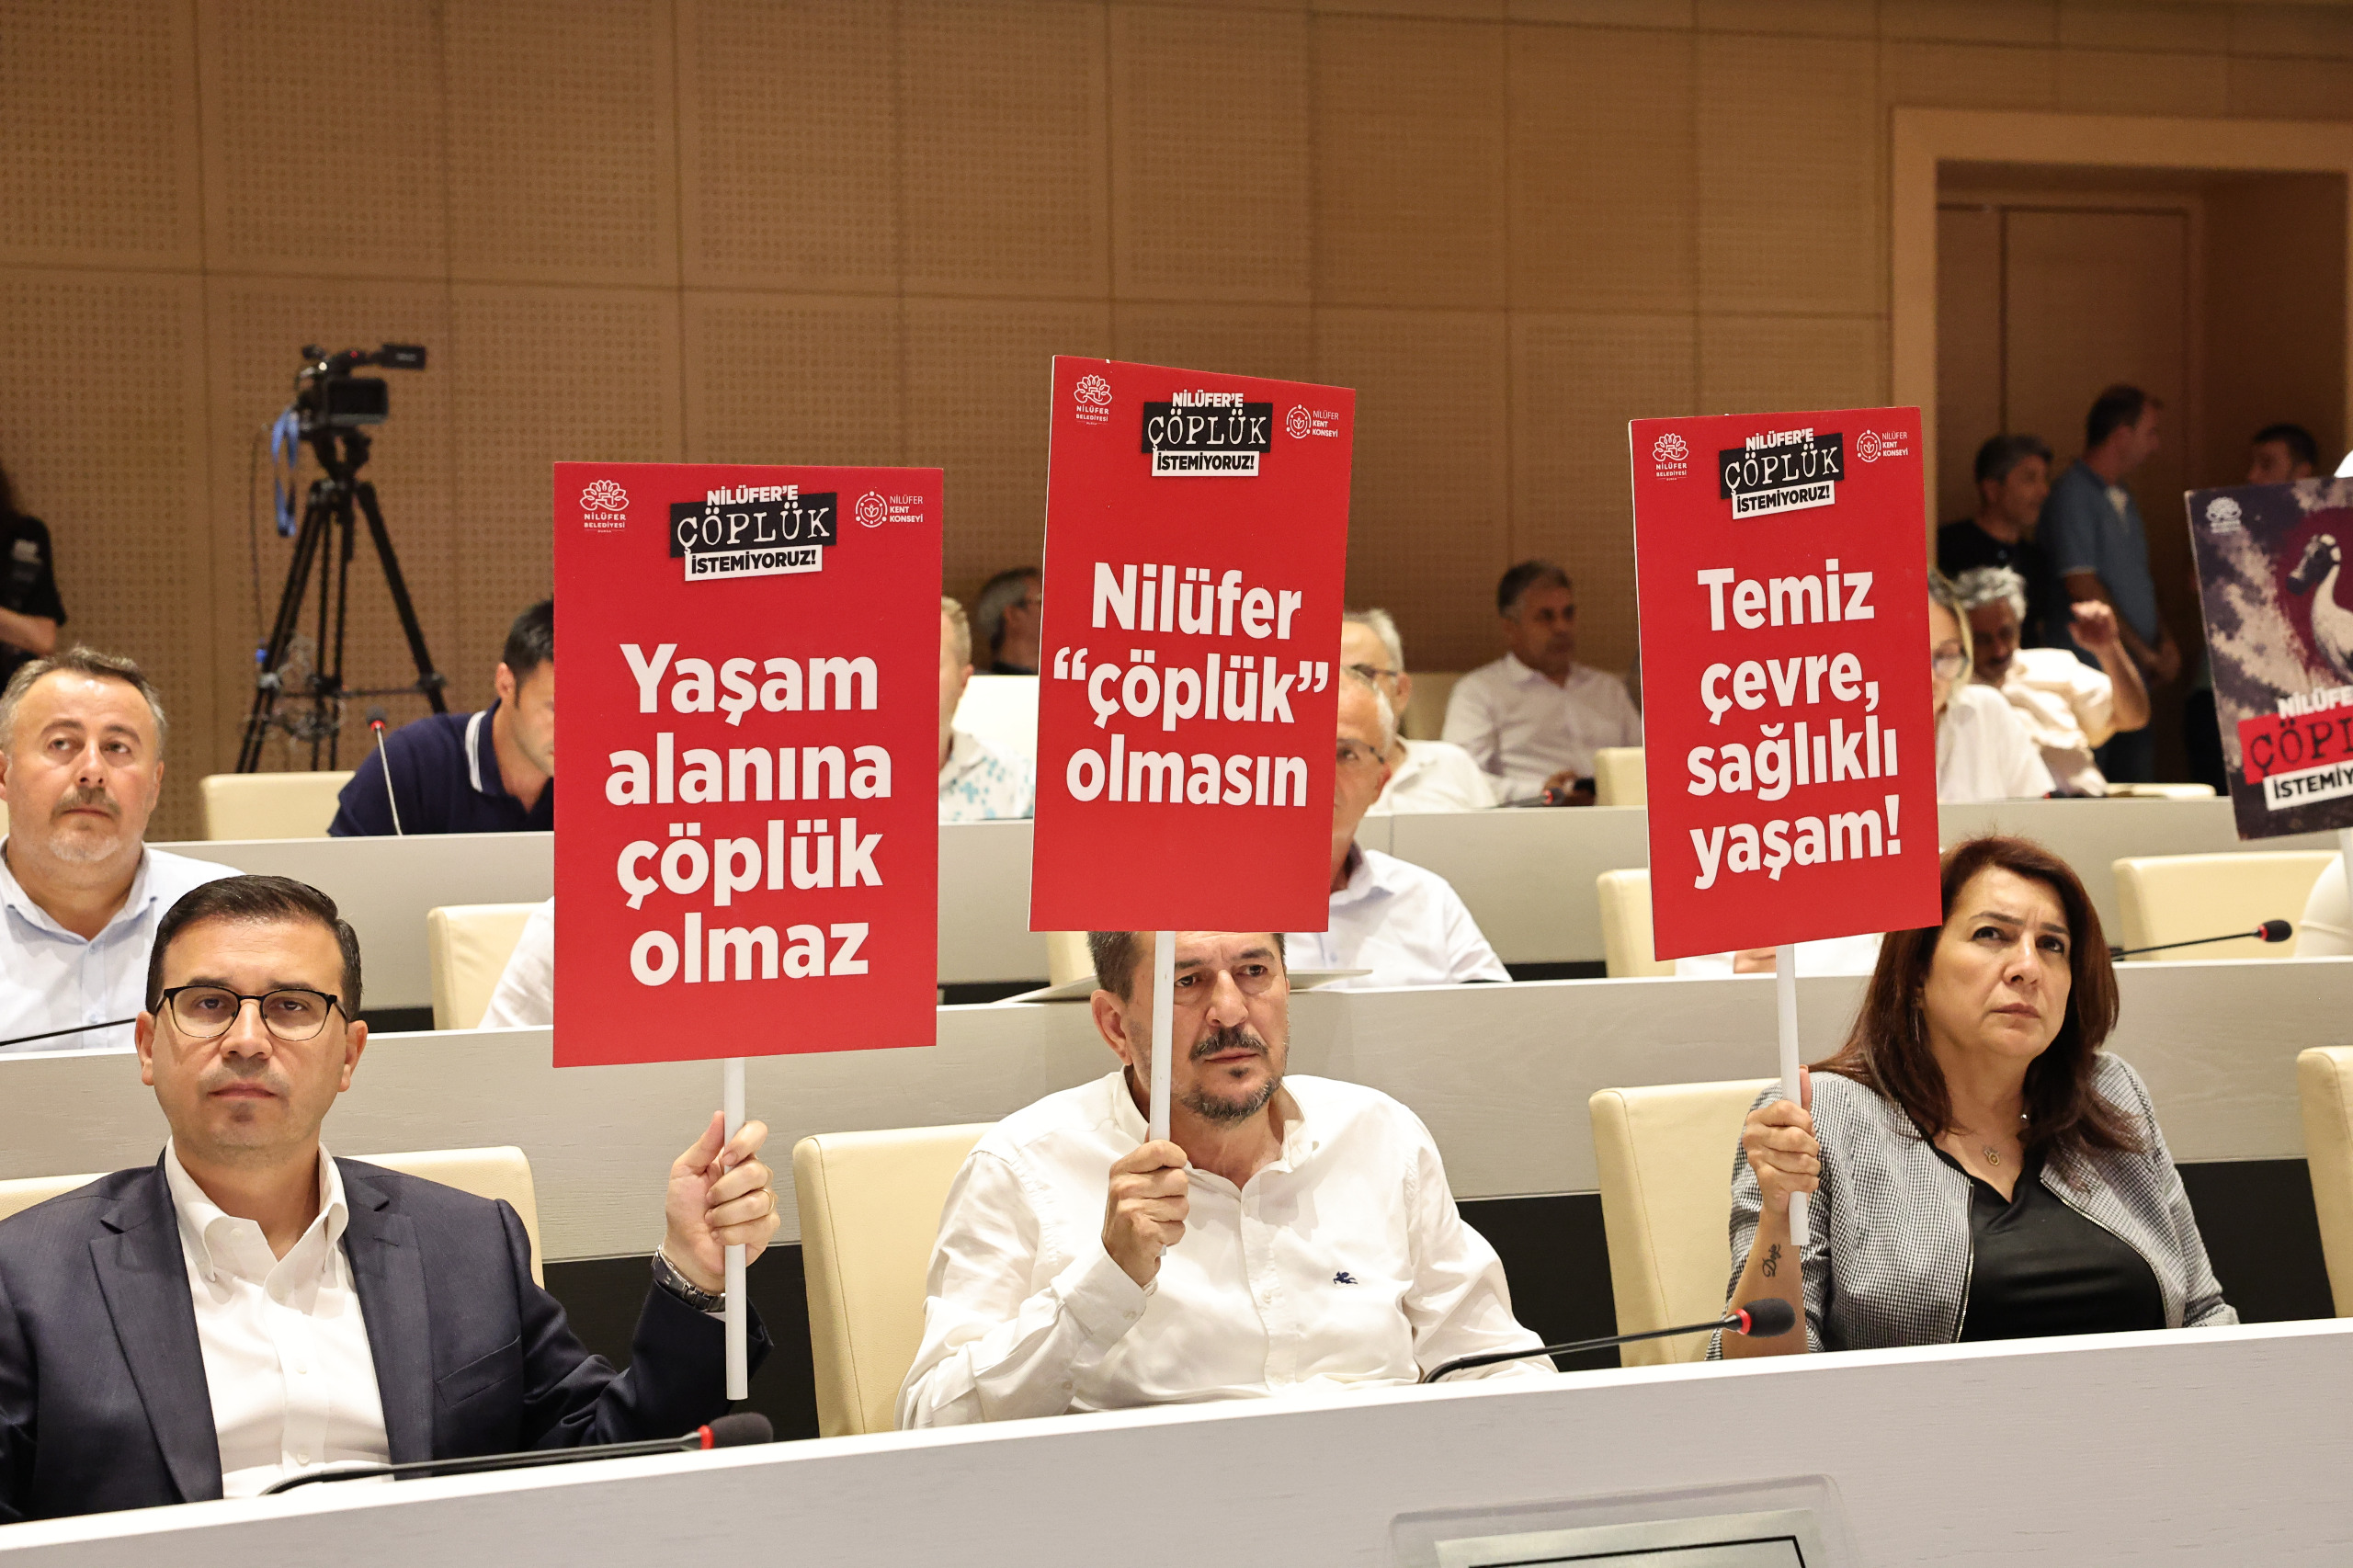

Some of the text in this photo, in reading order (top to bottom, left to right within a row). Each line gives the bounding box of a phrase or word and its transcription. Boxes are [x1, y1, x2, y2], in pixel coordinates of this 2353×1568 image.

[1076, 404, 1109, 415] NİLÜFER
[1313, 420, 1329, 428] KENT
[1148, 408, 1267, 451] ÇÖPLÜK
[1312, 428, 1338, 437] KONSEYİ
[1156, 452, 1255, 471] İSTEMİYORUZ!
[1655, 461, 1688, 471] NİLÜFER
[1725, 444, 1840, 495] ÇÖPLÜK
[1882, 447, 1909, 457] KONSEYİ
[584, 511, 627, 521] NİLÜFER
[890, 494, 923, 505] NİLÜFER
[890, 506, 910, 514] KENT
[1736, 485, 1831, 514] İSTEMİYORUZ!
[584, 520, 626, 528] BELEDİYESİ
[676, 501, 830, 554] ÇÖPLÜK
[889, 513, 924, 523] KONSEYİ
[691, 549, 816, 574] İSTEMİYORUZ!
[1092, 562, 1302, 640] Nilüfer
[1697, 558, 1875, 631] Temiz
[620, 643, 878, 726] Yaşam
[1700, 652, 1880, 726] çevre,
[605, 732, 892, 806] alanına
[1066, 733, 1308, 807] olmasın
[1687, 714, 1898, 802] sağlıklı
[1689, 794, 1902, 891] yaşam!
[617, 817, 884, 910] çöplük
[630, 912, 870, 986] olmaz
